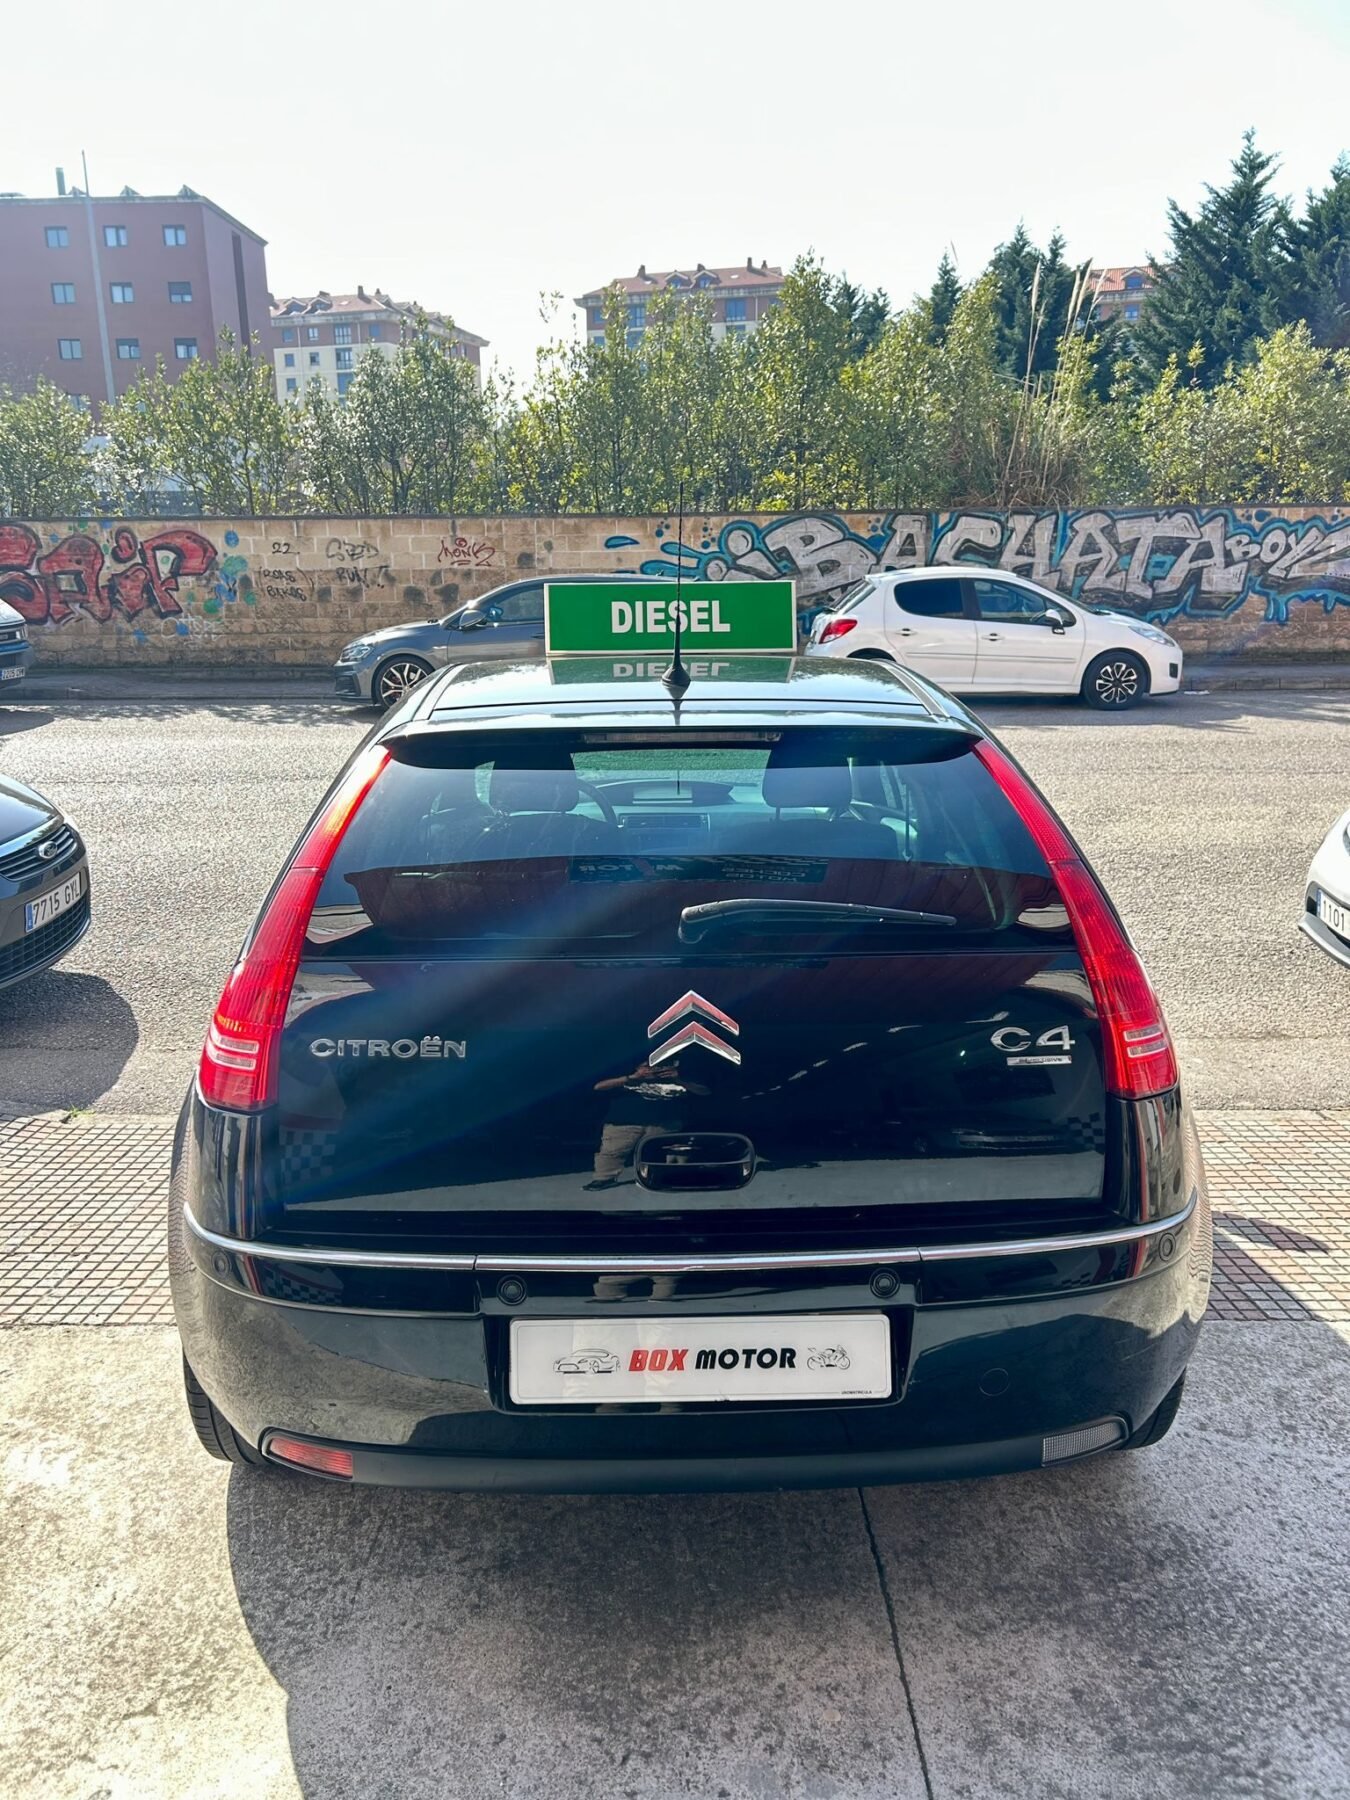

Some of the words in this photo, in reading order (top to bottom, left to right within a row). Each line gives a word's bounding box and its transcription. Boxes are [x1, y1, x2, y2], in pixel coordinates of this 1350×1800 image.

[611, 600, 731, 634] DIESEL
[33, 891, 60, 925] 7715
[65, 879, 80, 904] GYL
[1323, 900, 1345, 931] 1101
[309, 1036, 467, 1058] CITROËN
[990, 1025, 1075, 1052] C4
[628, 1348, 689, 1372] BOX
[695, 1348, 796, 1370] MOTOR
